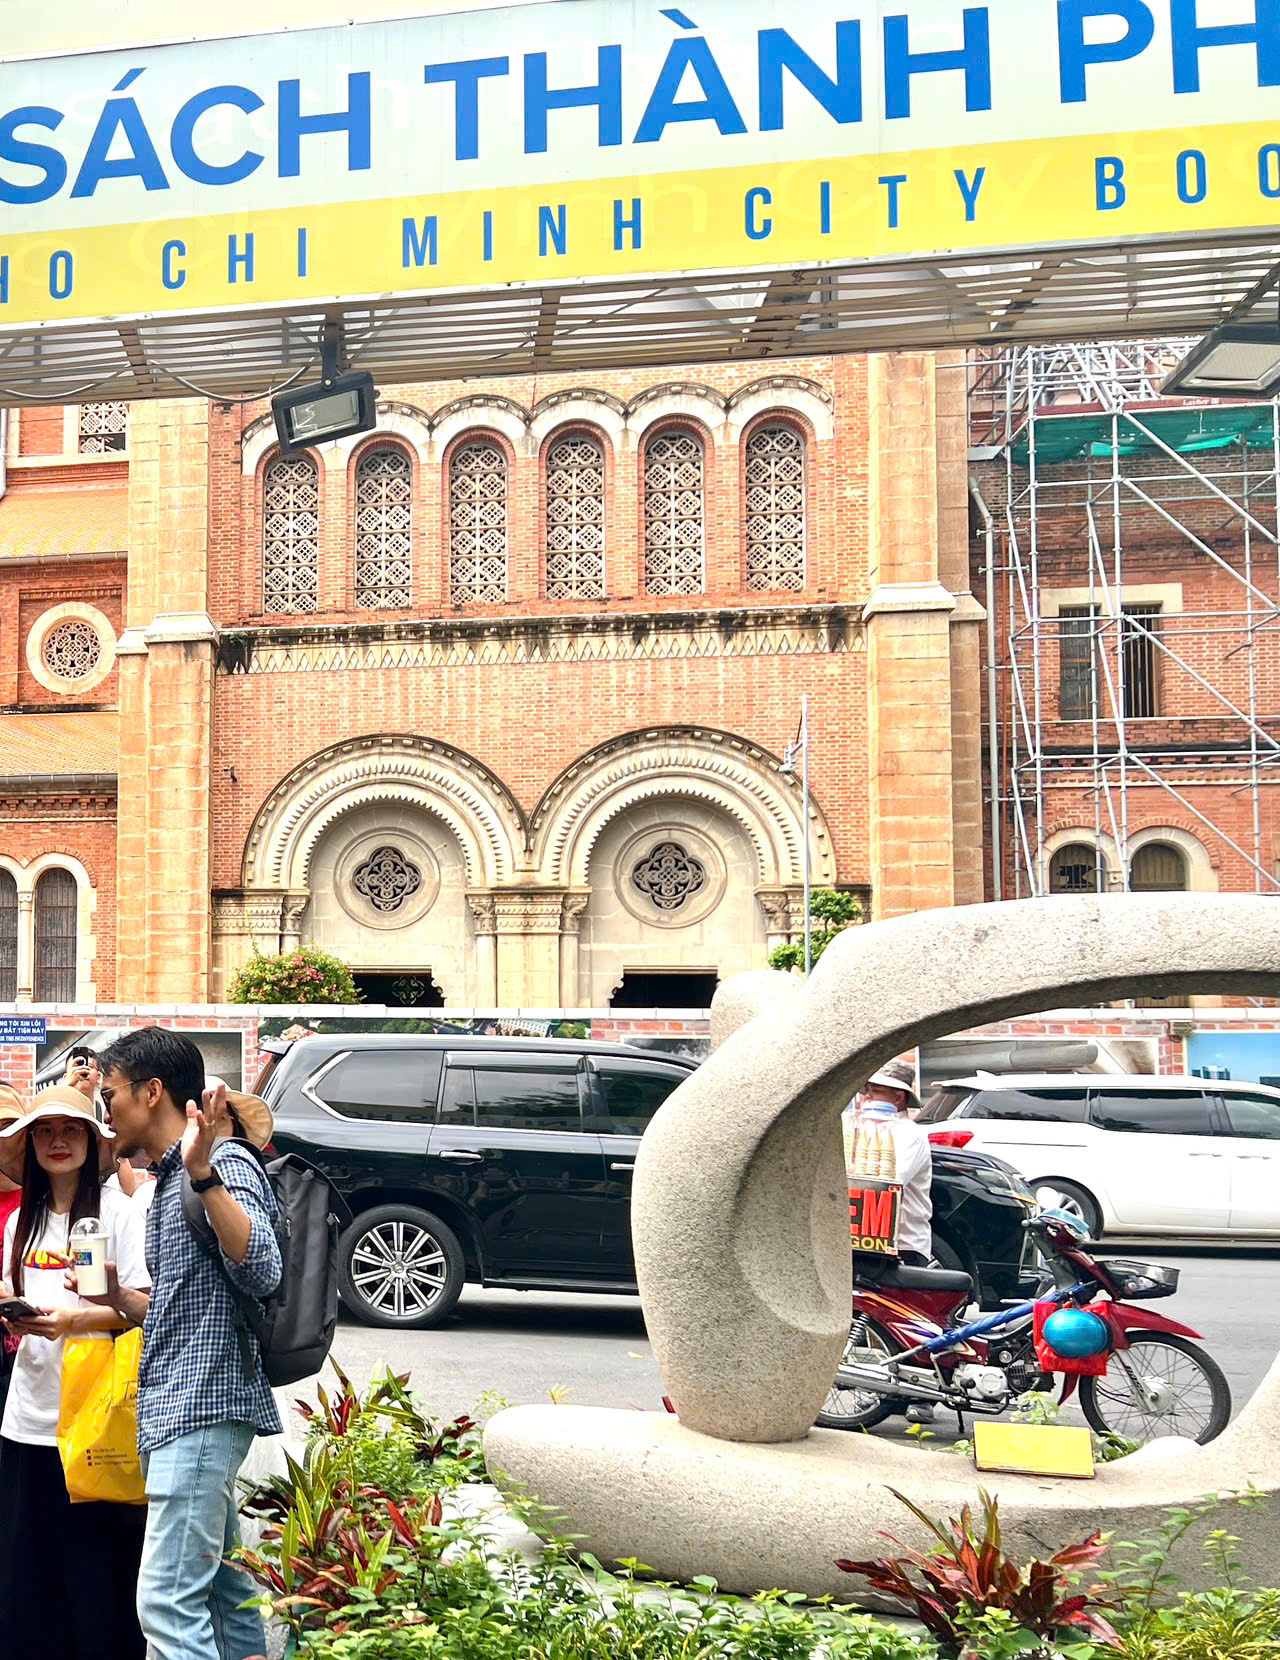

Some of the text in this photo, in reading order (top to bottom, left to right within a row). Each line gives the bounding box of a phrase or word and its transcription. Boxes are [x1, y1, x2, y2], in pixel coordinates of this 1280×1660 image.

[424, 8, 992, 161] THÀNH
[1056, 0, 1280, 104] PH
[162, 228, 308, 289] CHI
[402, 198, 643, 268] MINH
[743, 167, 986, 241] CITY
[1094, 143, 1280, 211] BOO
